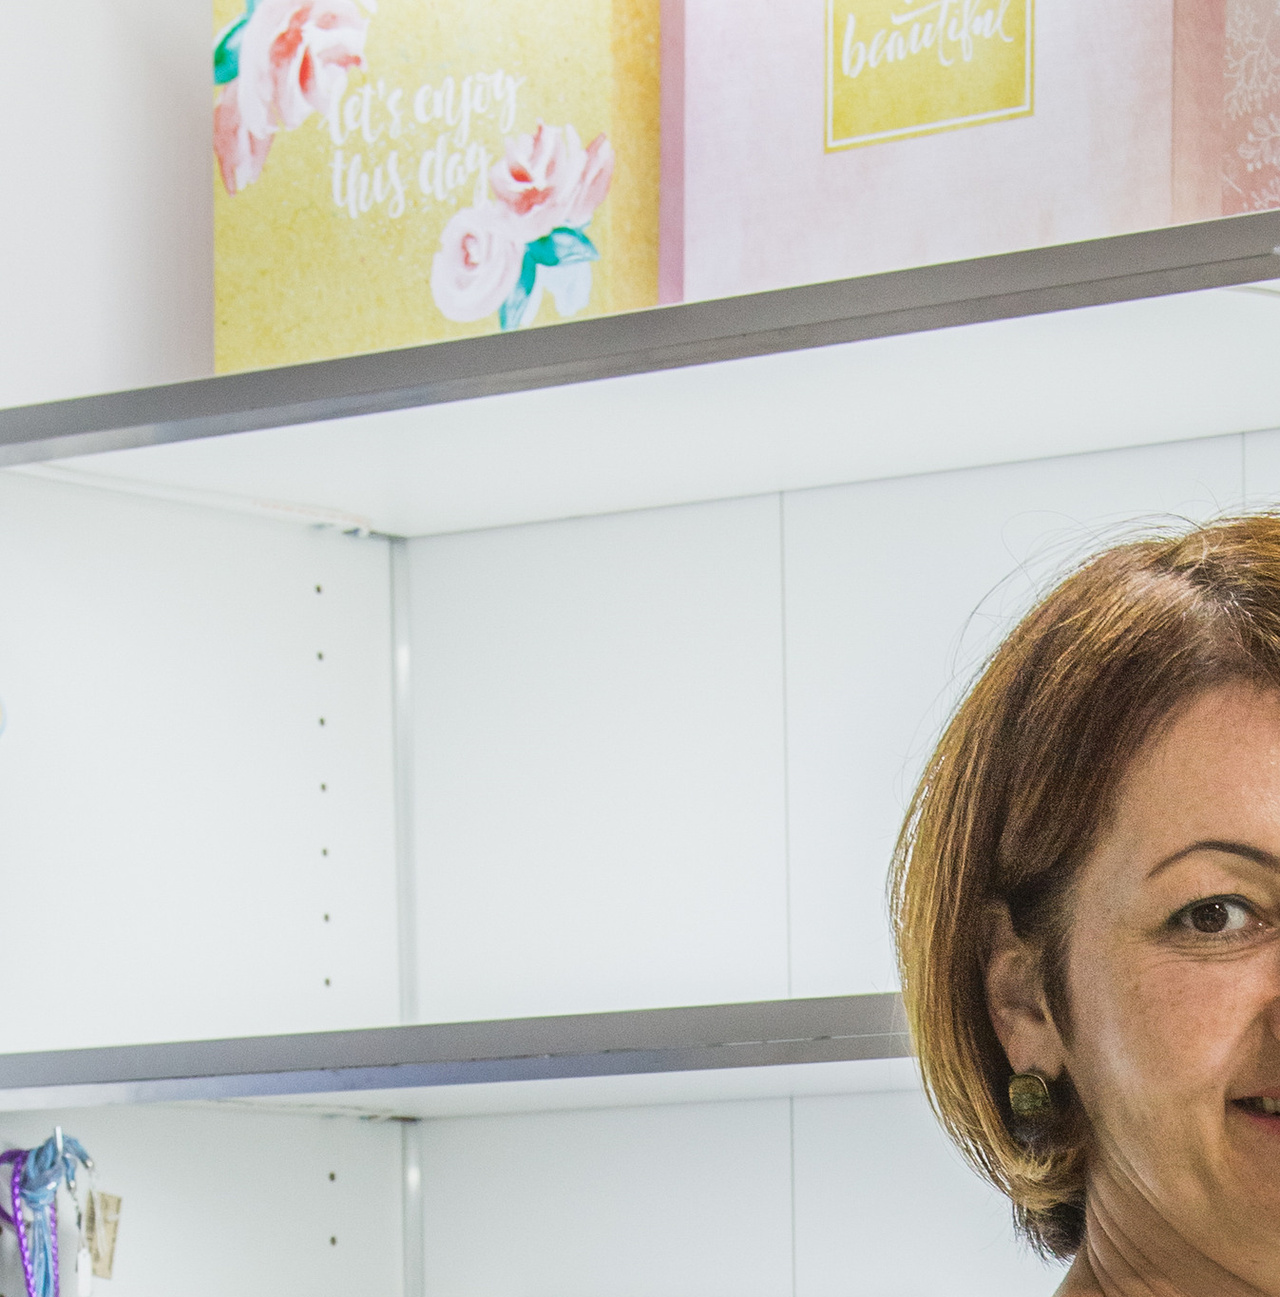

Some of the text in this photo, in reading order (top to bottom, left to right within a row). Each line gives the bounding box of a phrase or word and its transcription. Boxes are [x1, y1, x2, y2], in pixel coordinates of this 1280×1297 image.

[842, 0, 1014, 79] beautiful
[413, 69, 527, 148] enjoy
[329, 132, 493, 219] this day
